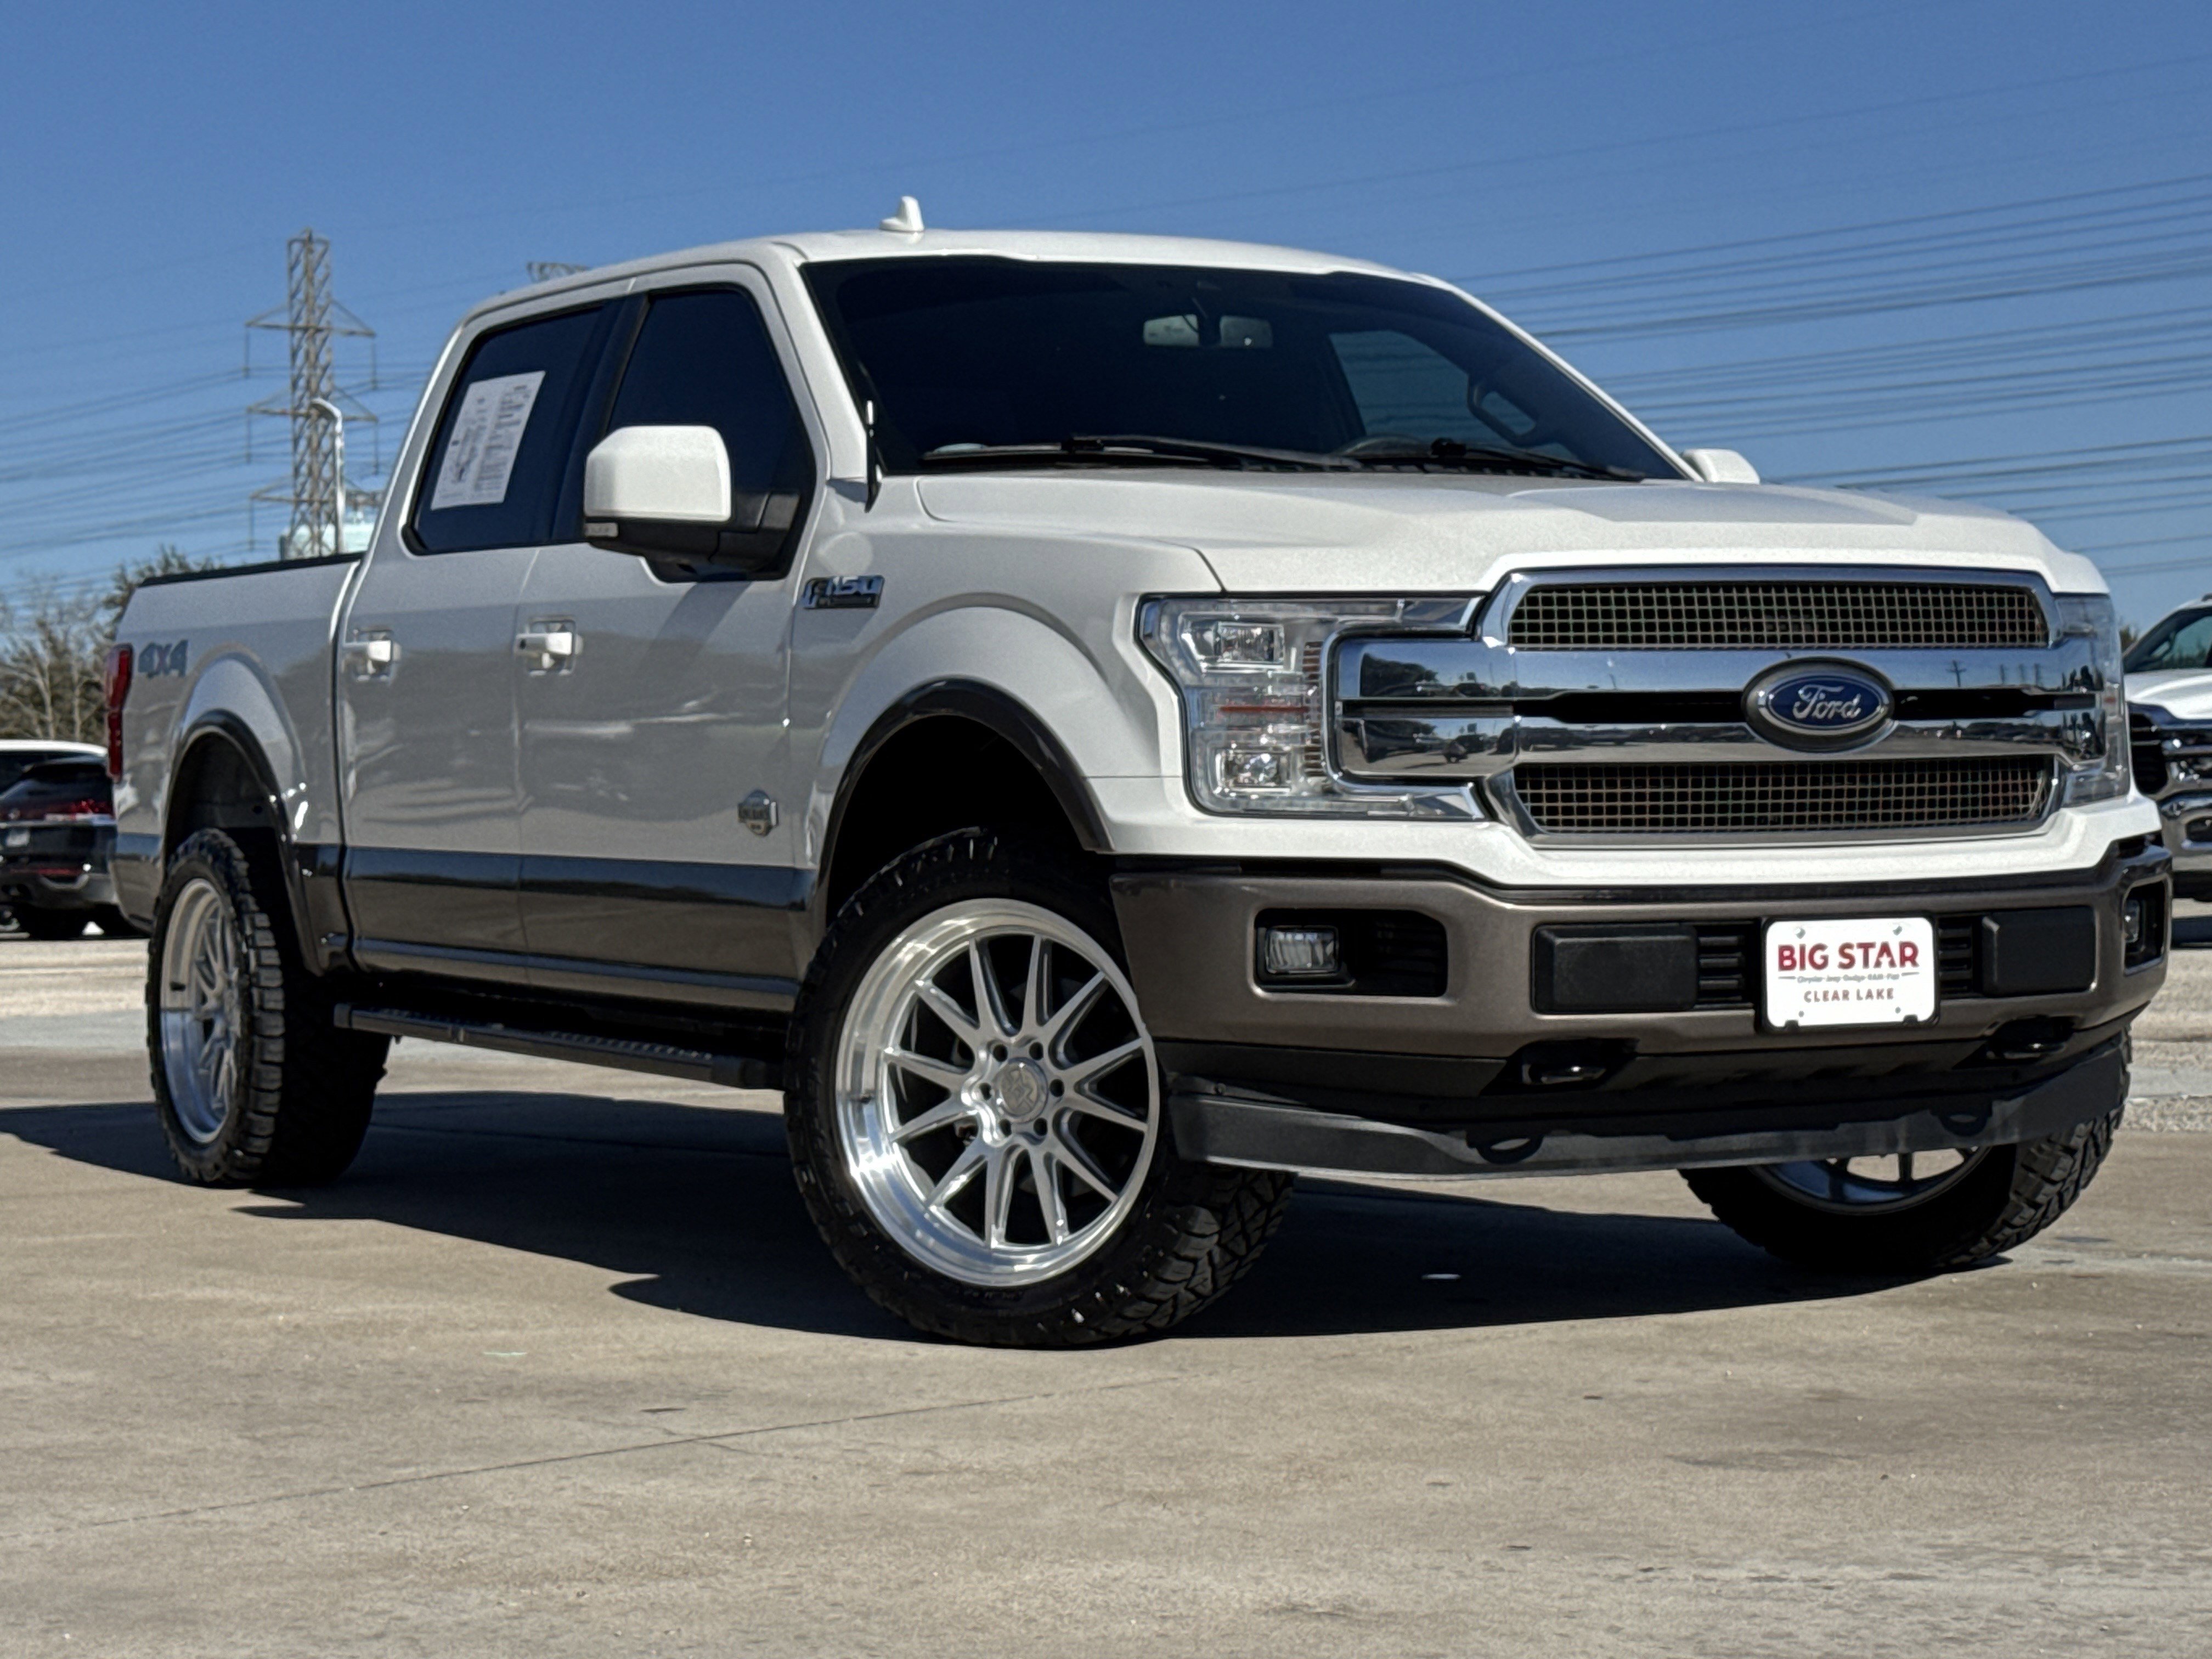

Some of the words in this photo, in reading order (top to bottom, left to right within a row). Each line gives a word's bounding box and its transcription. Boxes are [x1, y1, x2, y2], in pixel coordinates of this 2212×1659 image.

[1792, 684, 1861, 720] Ford
[1778, 943, 1829, 972] BIG
[1838, 941, 1920, 970] STAR
[1804, 990, 1850, 1003] CLEAR
[1856, 988, 1894, 1001] LAKE
